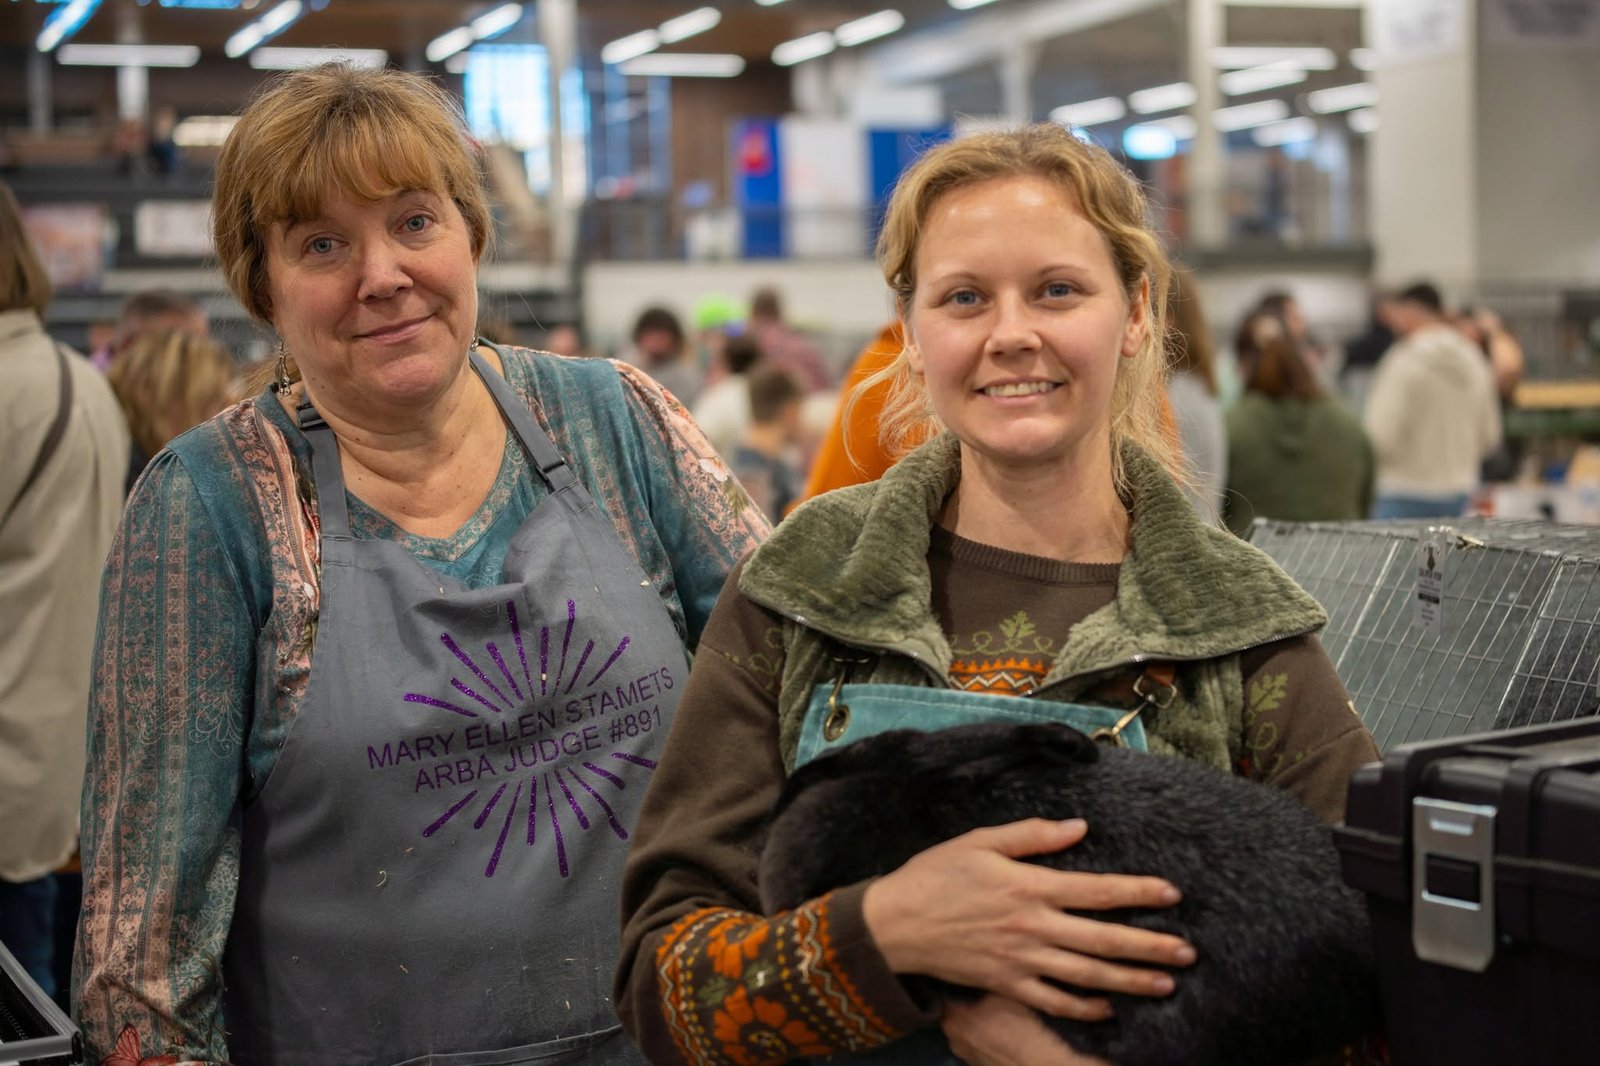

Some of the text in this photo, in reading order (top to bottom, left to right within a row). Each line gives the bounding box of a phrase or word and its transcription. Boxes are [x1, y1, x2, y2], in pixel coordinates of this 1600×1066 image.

[367, 667, 674, 770] MARY ELLEN STAMETS
[414, 704, 661, 793] ARBA JUDGE #891
